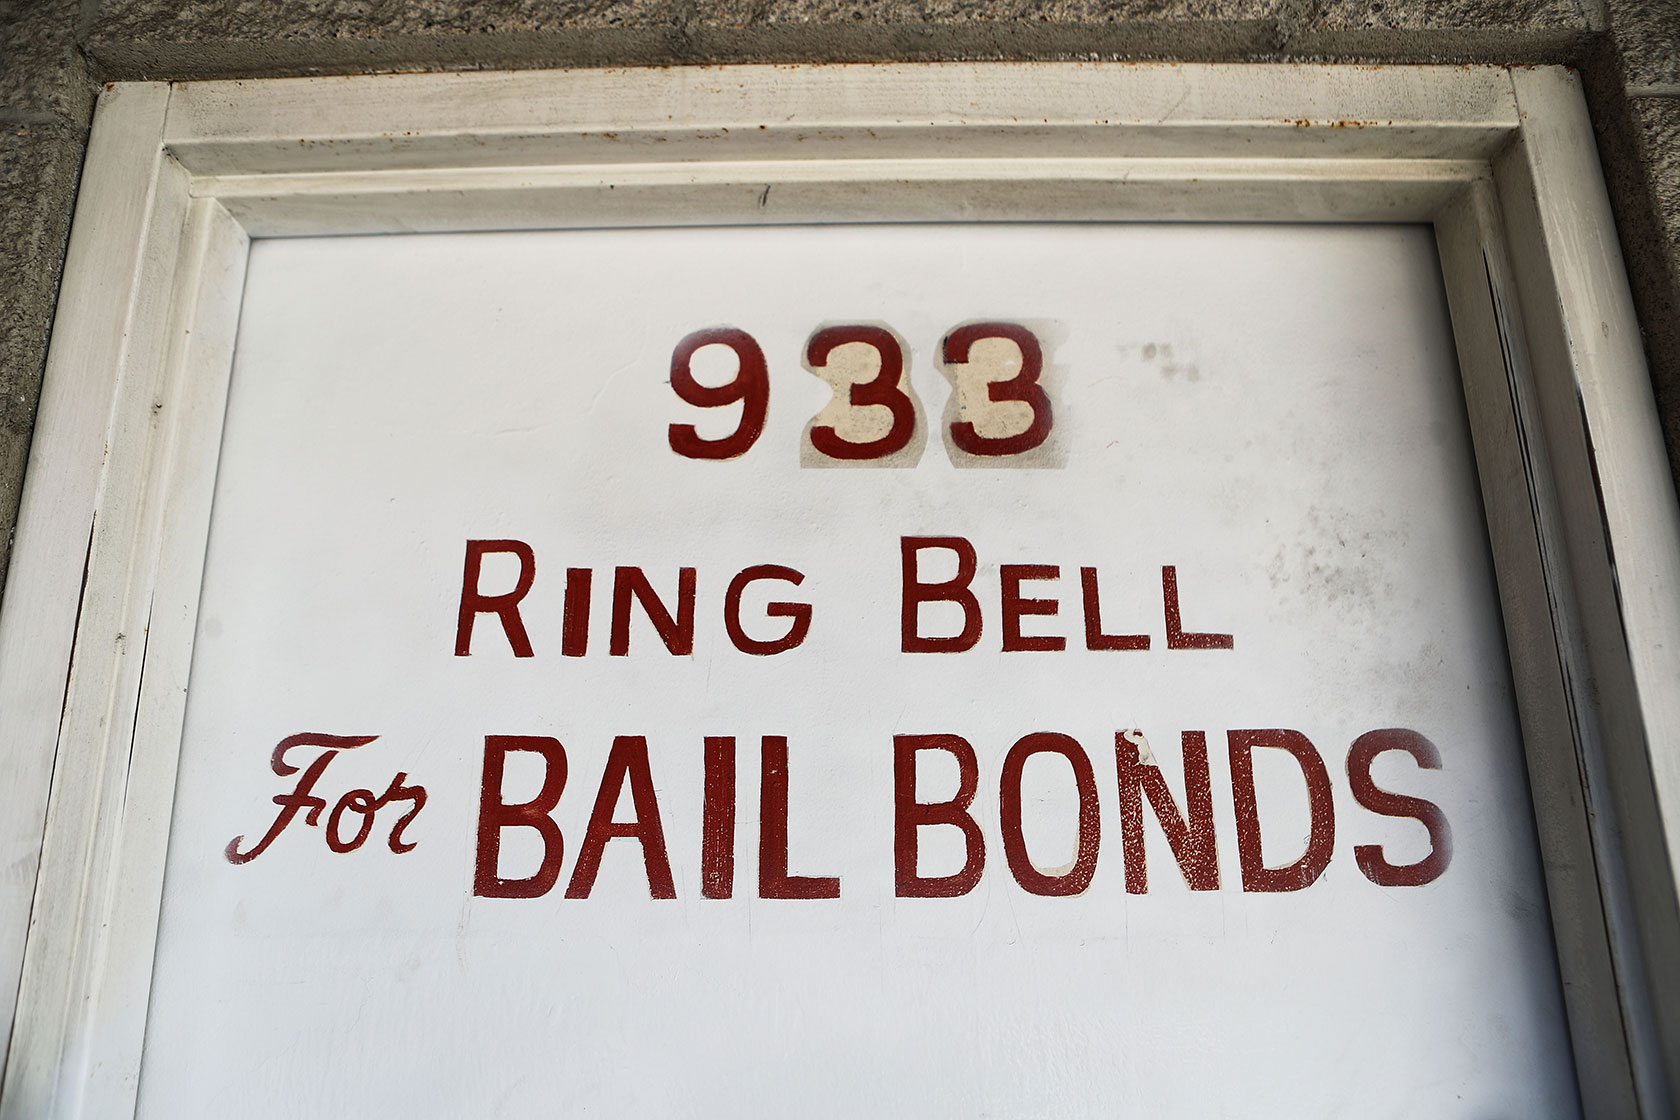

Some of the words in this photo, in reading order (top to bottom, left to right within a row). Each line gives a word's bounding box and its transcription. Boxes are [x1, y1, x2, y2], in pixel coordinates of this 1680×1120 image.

[669, 325, 1052, 460] 933
[455, 539, 812, 657] RING
[901, 536, 1234, 653] BELL
[225, 732, 428, 864] For
[474, 735, 841, 899] BAIL
[894, 728, 1453, 898] BONDS
